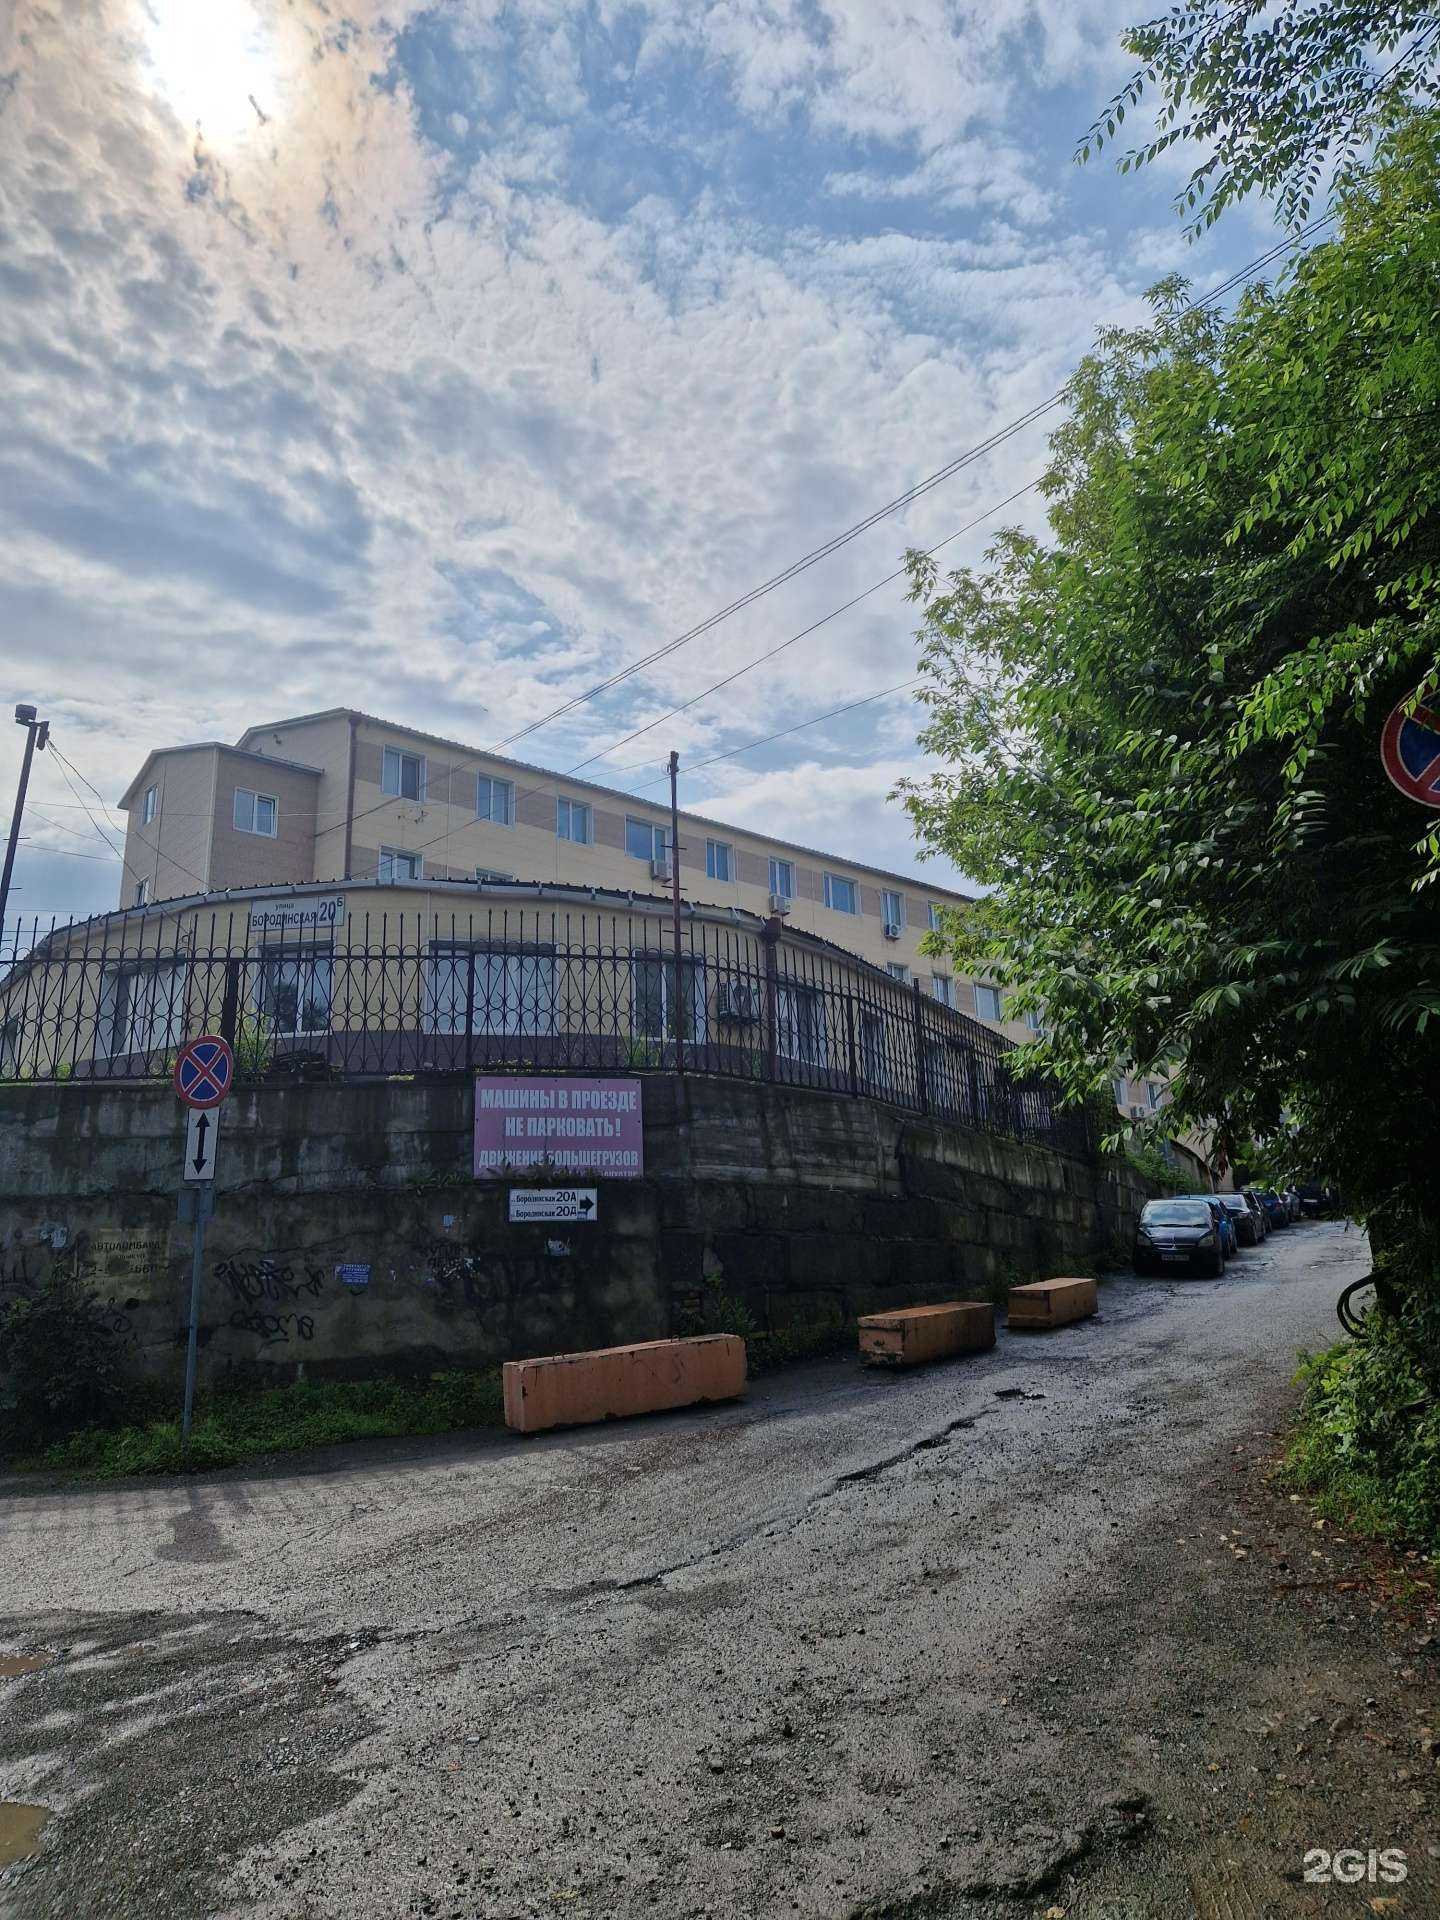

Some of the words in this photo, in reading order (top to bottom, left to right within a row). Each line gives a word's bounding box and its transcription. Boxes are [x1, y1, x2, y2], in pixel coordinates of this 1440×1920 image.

[275, 903, 295, 911] улица
[480, 1088, 554, 1109] МАШИНЫ
[558, 1090, 568, 1109] В
[571, 1090, 637, 1113] ПРОЕЗДЕ
[505, 1117, 524, 1137] НЕ
[479, 1150, 545, 1168] ДВИЖЕНИЕ
[556, 1191, 577, 1202] 20А
